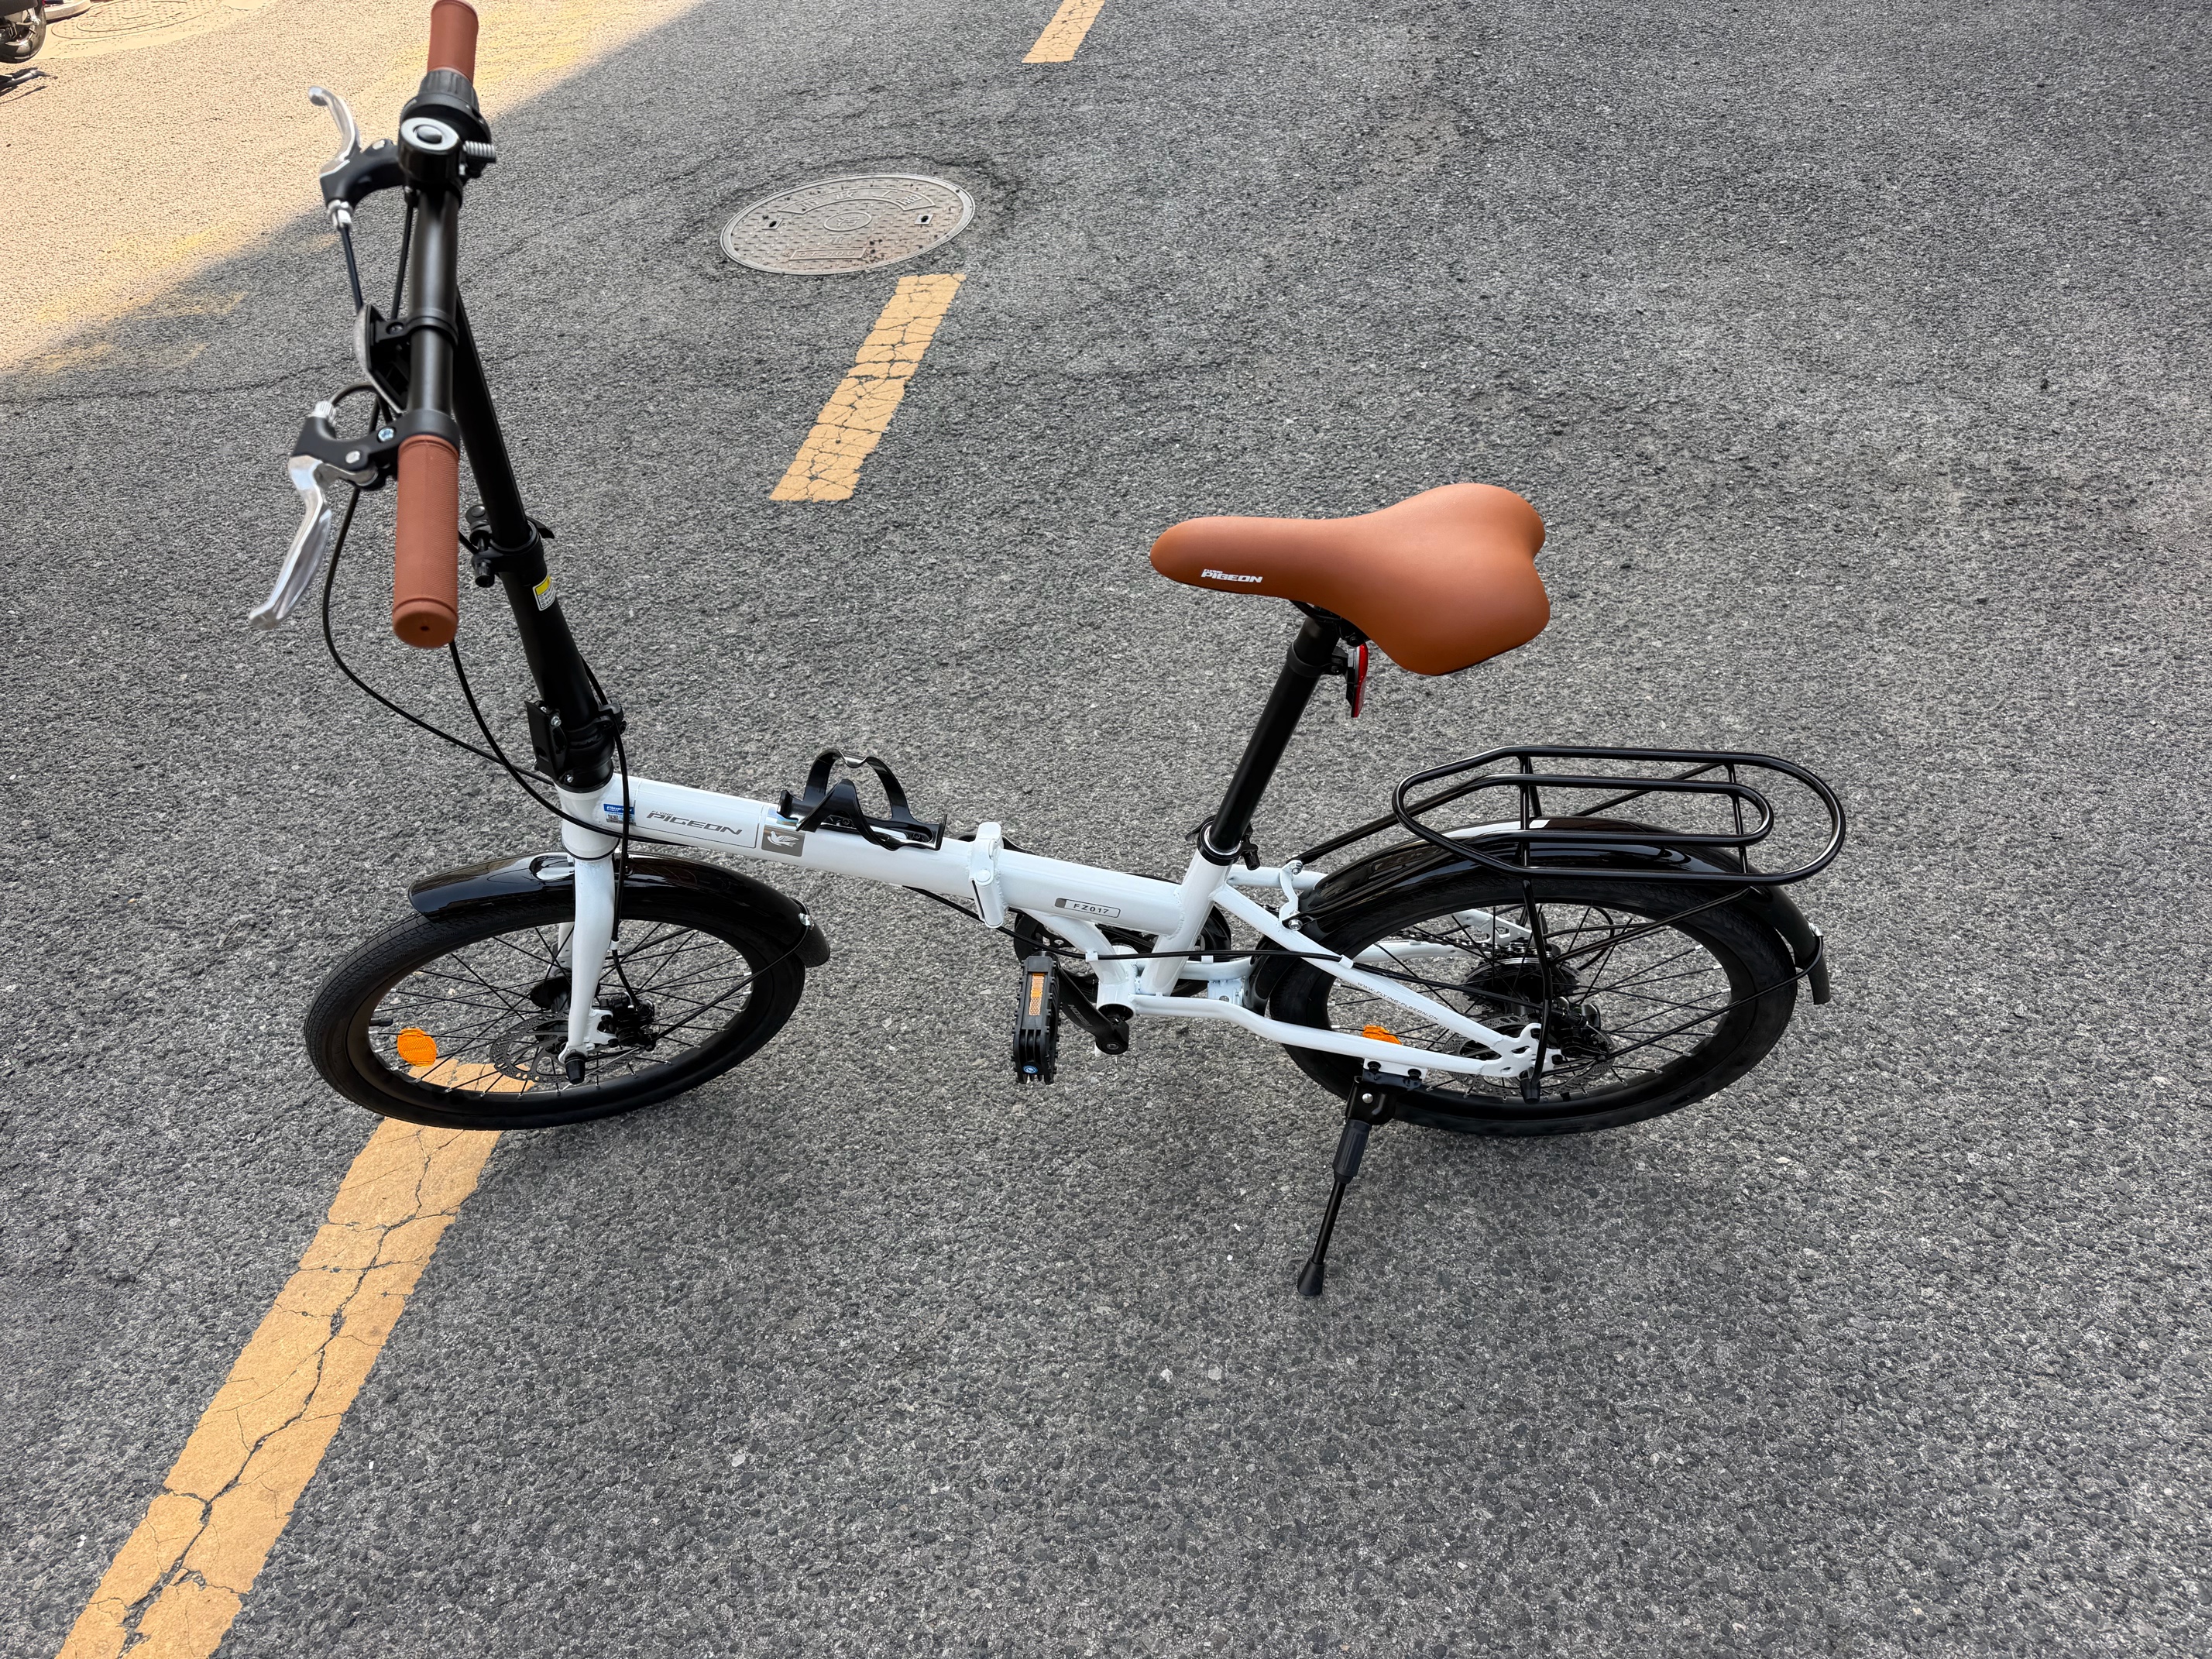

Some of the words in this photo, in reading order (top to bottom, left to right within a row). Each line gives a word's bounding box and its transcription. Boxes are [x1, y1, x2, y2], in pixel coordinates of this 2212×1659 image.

[1200, 571, 1263, 583] PIGEON
[646, 812, 743, 836] PIGEON
[1073, 903, 1109, 914] FZ017
